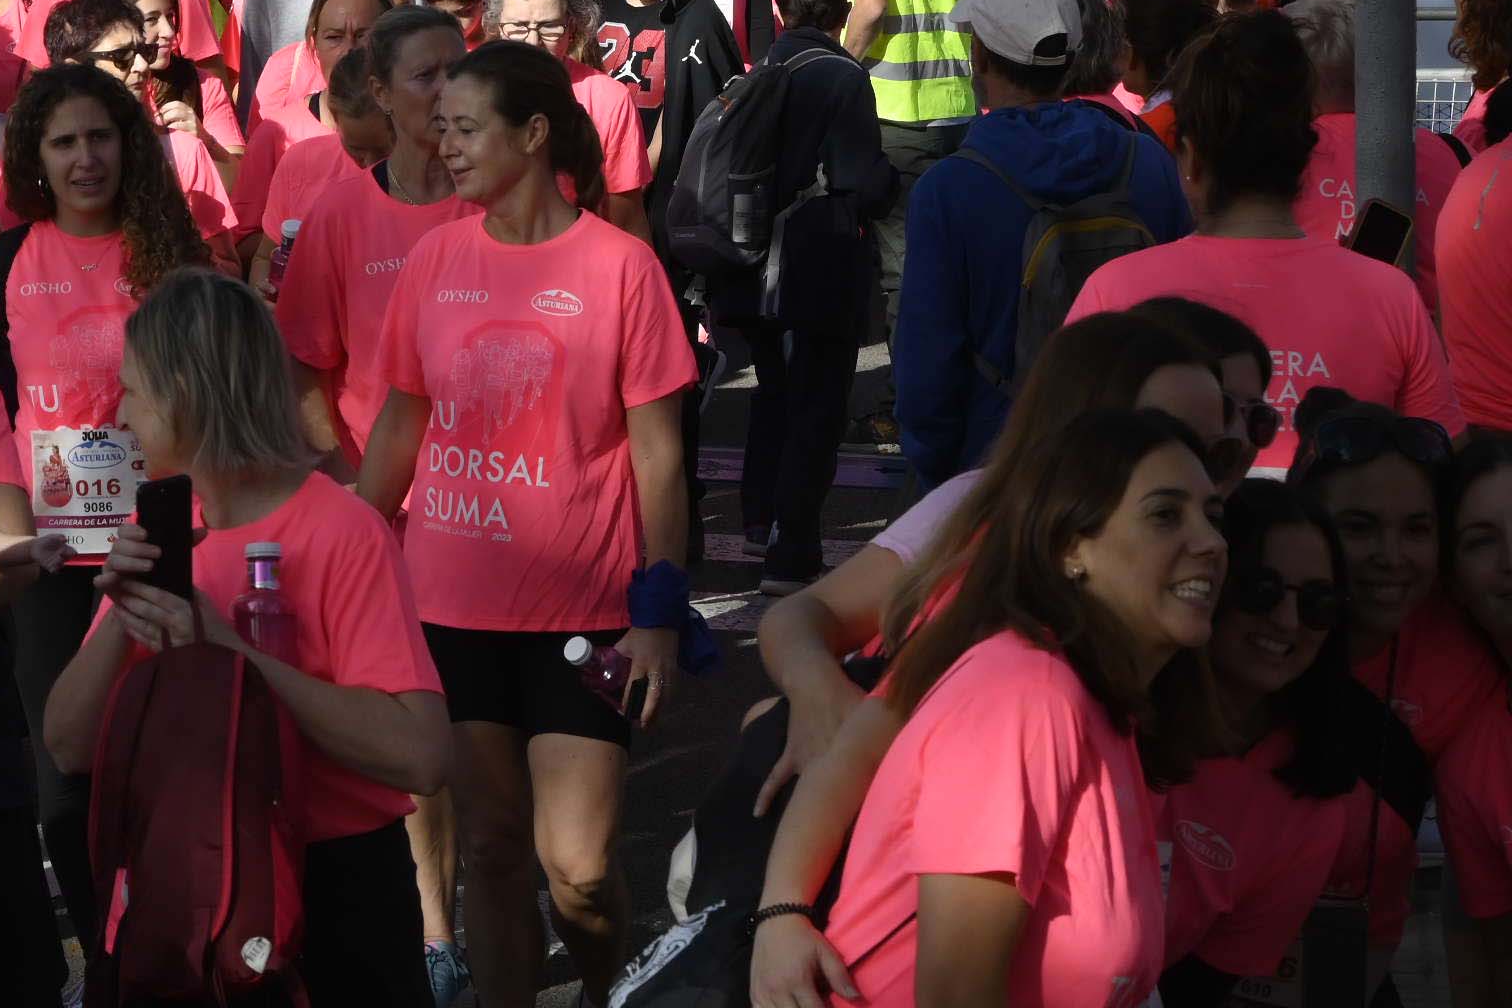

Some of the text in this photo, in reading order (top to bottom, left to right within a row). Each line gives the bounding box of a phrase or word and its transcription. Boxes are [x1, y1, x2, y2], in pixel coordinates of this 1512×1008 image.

[20, 281, 72, 296] OYSHO
[437, 289, 489, 304] OYSHO
[535, 297, 579, 313] ASTURIANA
[73, 452, 122, 462] ASTURIANA
[429, 442, 550, 488] DORSAL
[75, 478, 121, 497] 016
[84, 502, 113, 513] 9086
[424, 486, 508, 529] SUMA
